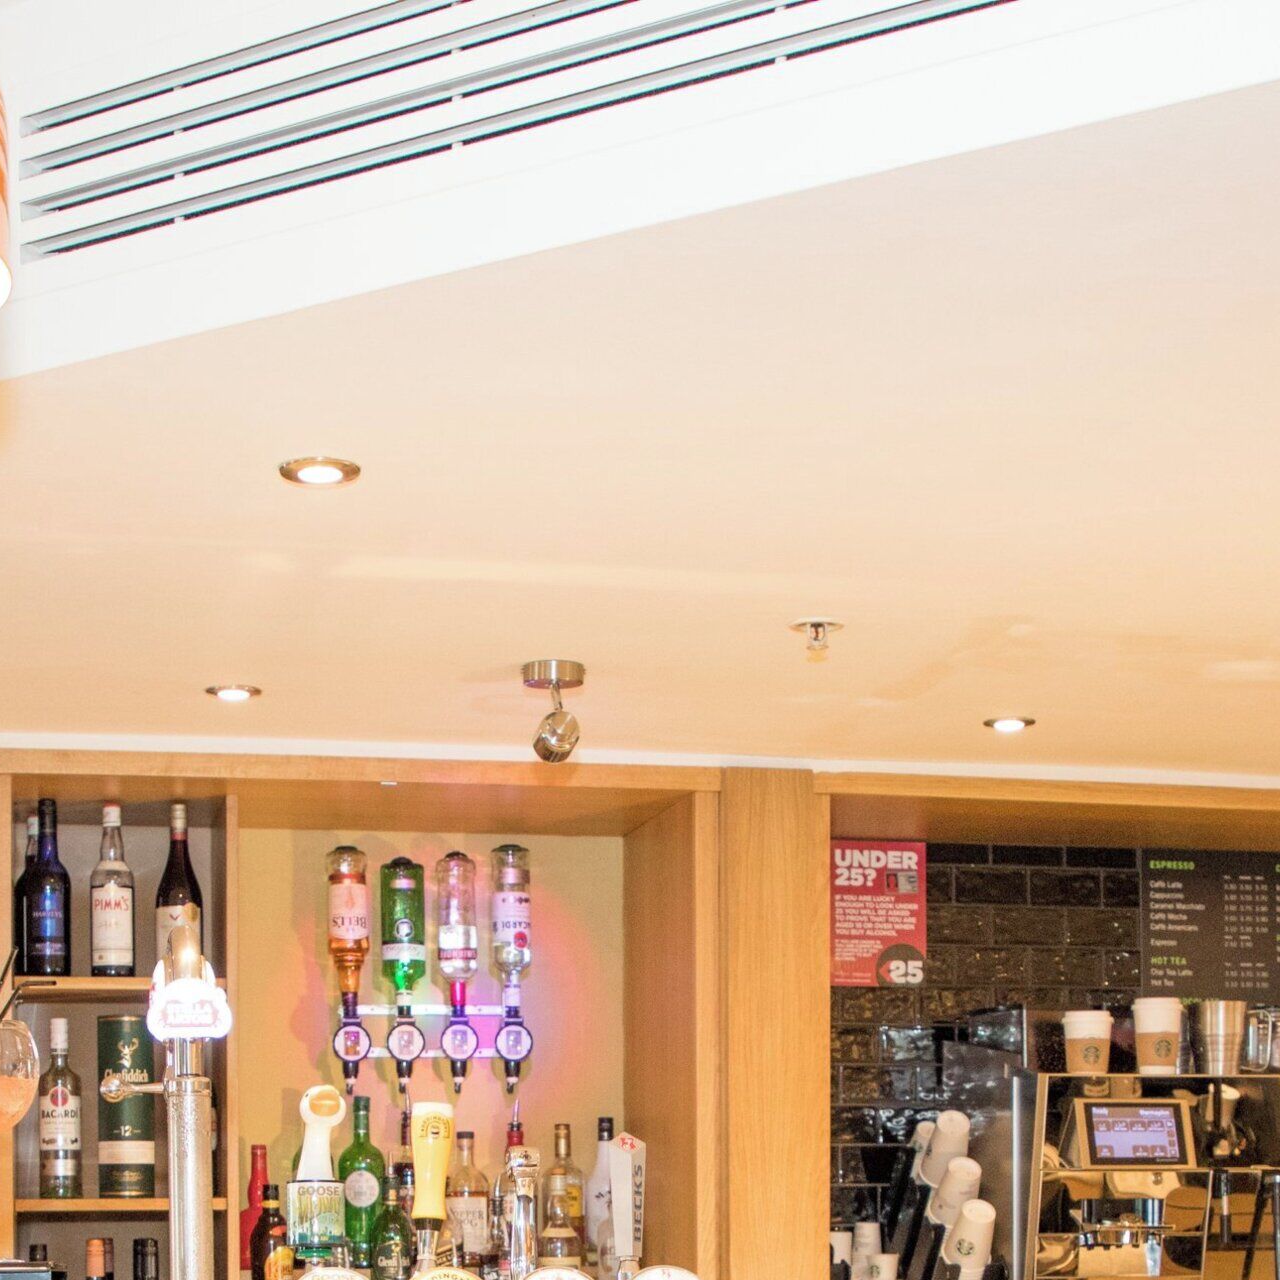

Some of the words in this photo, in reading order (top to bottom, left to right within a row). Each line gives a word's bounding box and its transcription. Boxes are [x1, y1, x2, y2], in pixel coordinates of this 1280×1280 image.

[834, 848, 918, 870] UNDER
[1149, 860, 1195, 870] ESPRESSO
[834, 868, 877, 887] 25?
[93, 896, 130, 912] PIMM'S
[1171, 957, 1187, 965] TEA
[889, 960, 924, 984] 25
[121, 1125, 133, 1137] 12
[297, 1185, 340, 1197] GOOSE
